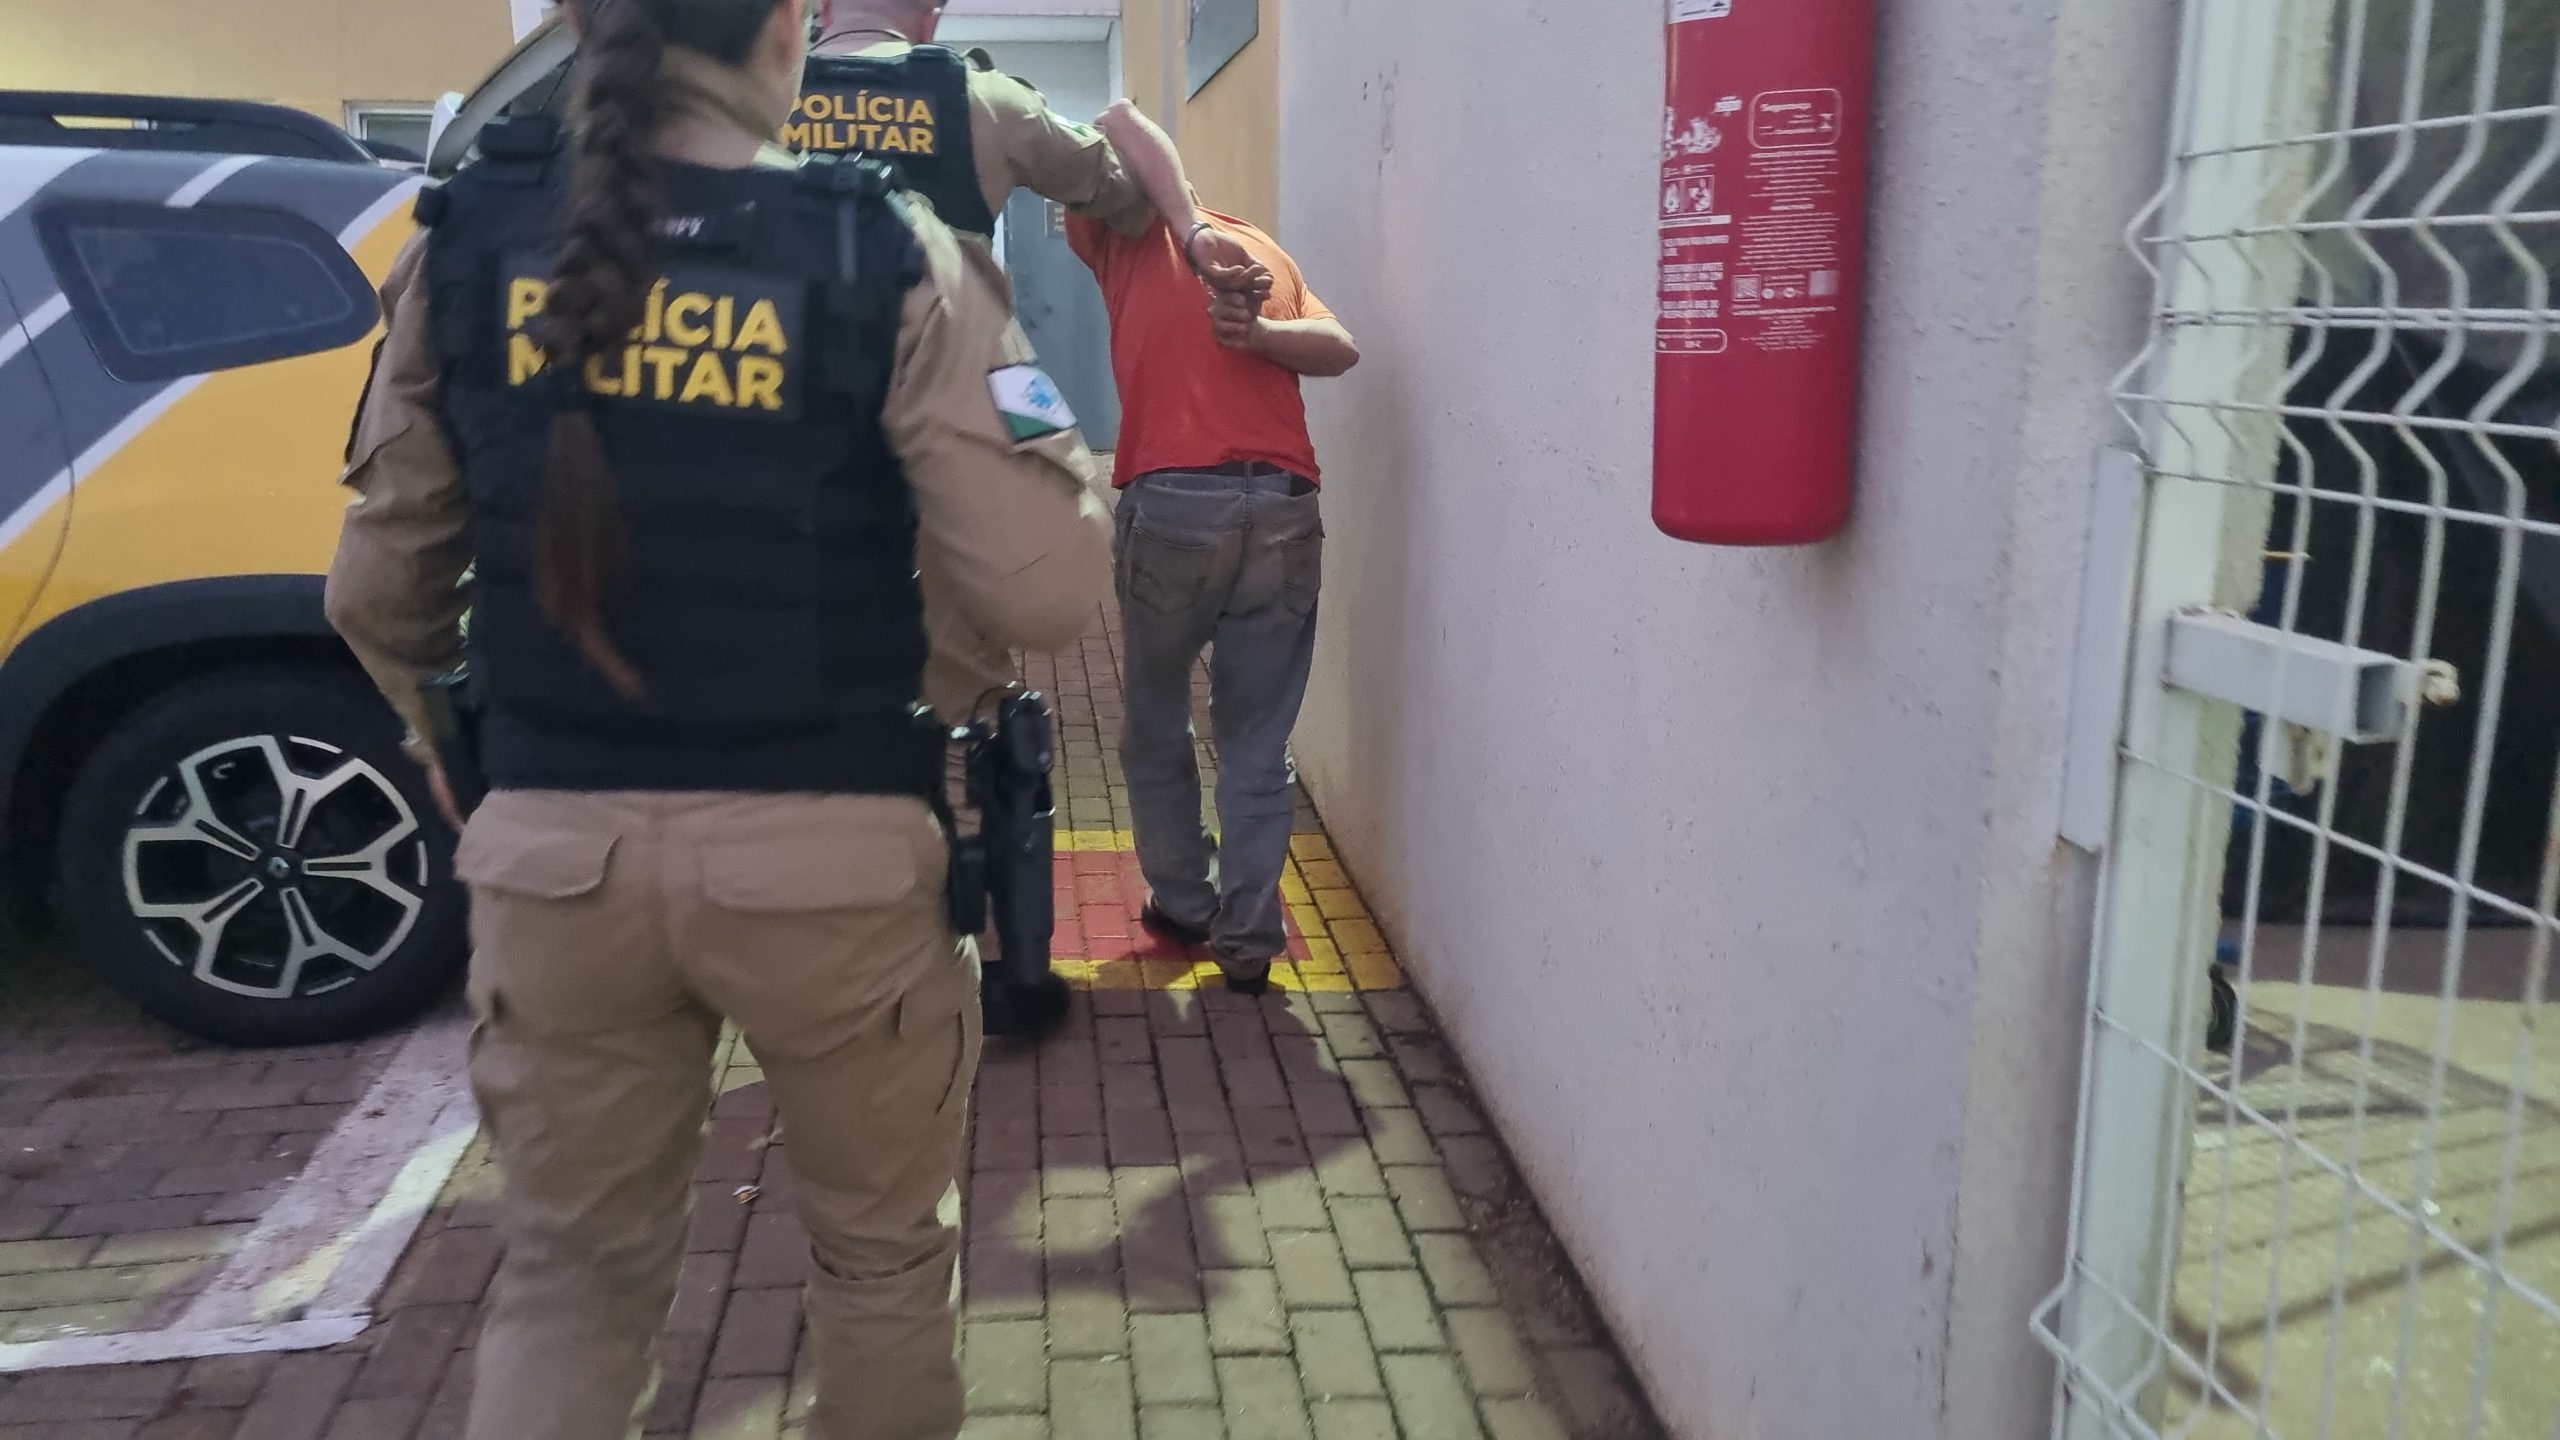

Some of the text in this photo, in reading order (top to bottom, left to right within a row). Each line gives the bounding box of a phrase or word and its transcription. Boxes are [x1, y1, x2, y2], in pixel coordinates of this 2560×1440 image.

[783, 122, 934, 154] MILITAR
[506, 276, 788, 355] PÍCIA
[508, 331, 784, 410] MLITAR
